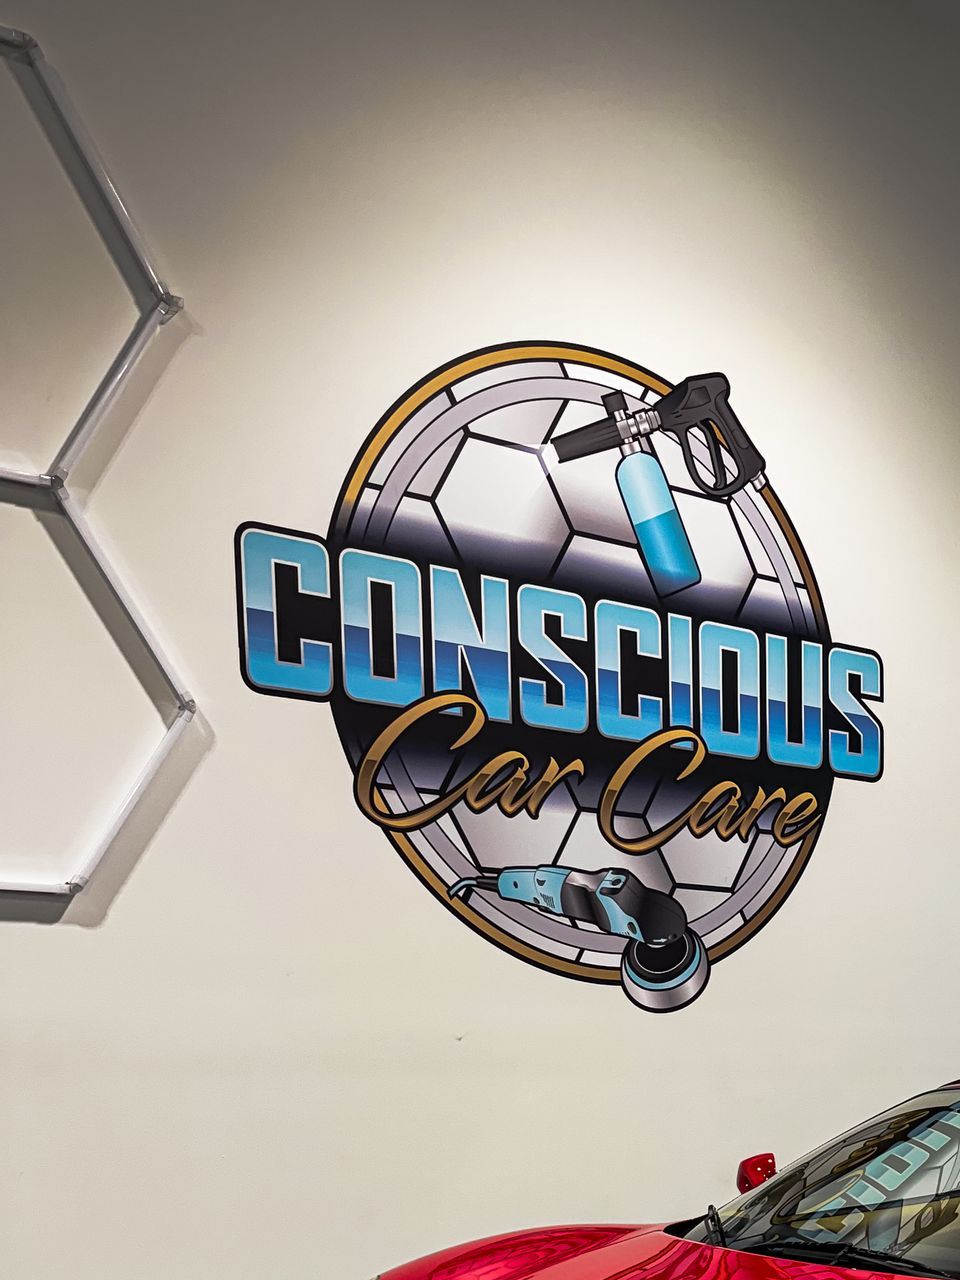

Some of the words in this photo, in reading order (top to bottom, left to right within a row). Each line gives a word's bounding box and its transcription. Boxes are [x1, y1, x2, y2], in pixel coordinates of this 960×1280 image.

[239, 525, 885, 780] CONSCIOUS
[354, 692, 586, 831] Car
[598, 727, 824, 853] Care
